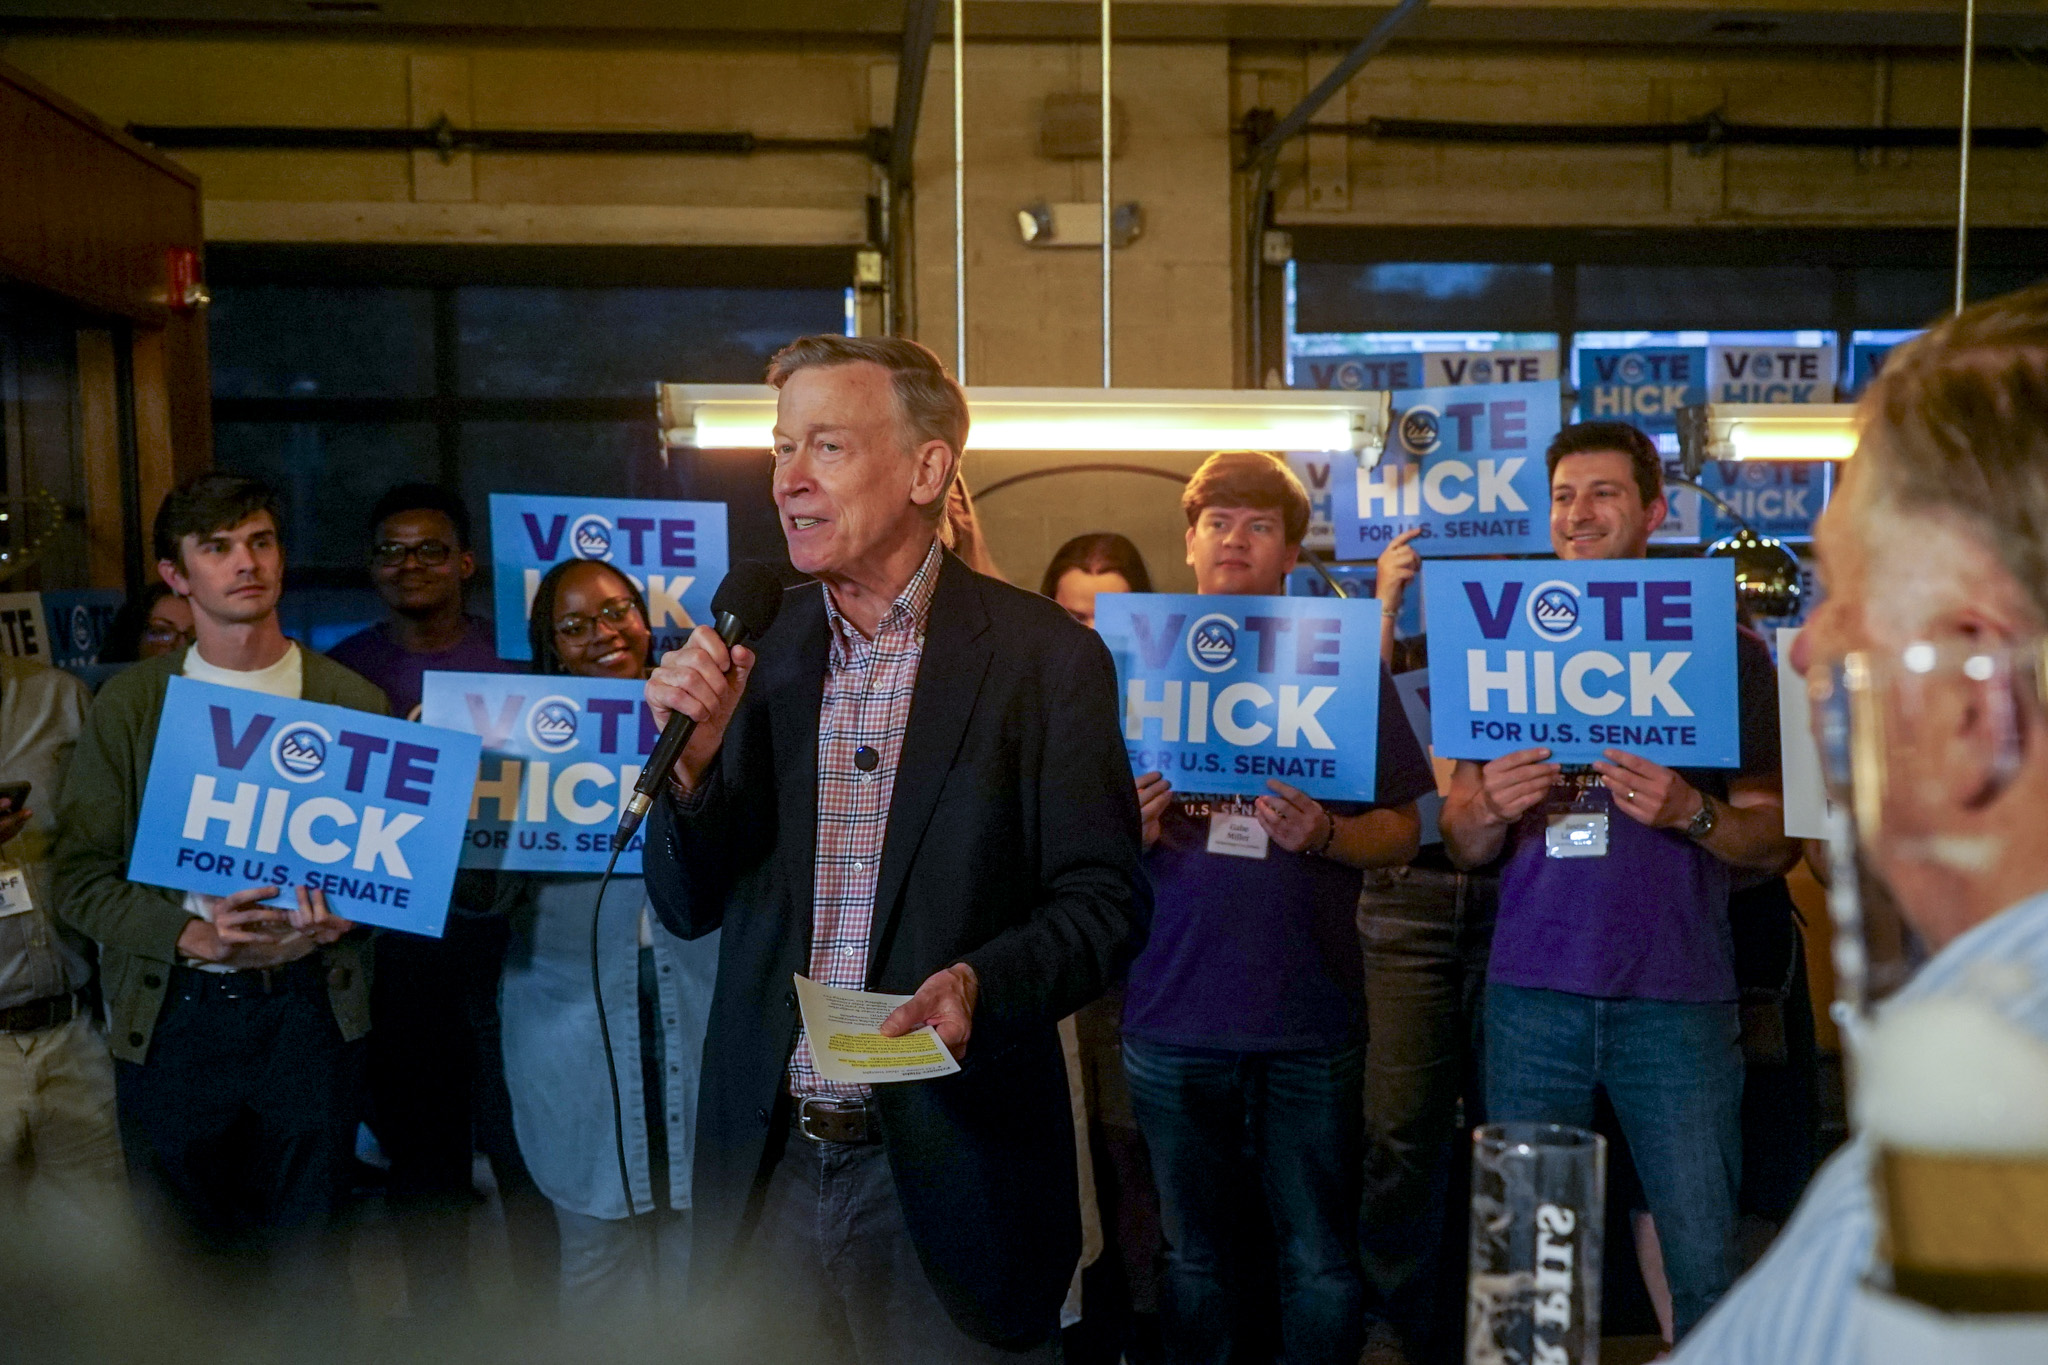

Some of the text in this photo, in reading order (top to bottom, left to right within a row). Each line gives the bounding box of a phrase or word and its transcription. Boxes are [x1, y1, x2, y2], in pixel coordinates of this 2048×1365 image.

[1309, 361, 1409, 389] VOTE
[1441, 357, 1540, 385] VOTE
[1595, 353, 1690, 383] VOTE
[1723, 353, 1820, 381] VOTE
[1593, 384, 1689, 416] HICK
[1391, 401, 1527, 455] OTE
[1356, 457, 1529, 519] HICK
[1716, 488, 1809, 519] HICK
[521, 512, 697, 567] VOTE
[1359, 525, 1393, 542] FOR
[1445, 518, 1531, 538] SENATE
[1462, 579, 1693, 643] VOTE
[1130, 613, 1342, 676] VOTE
[1466, 649, 1696, 717] HICK
[1125, 679, 1339, 750] HICK
[1470, 720, 1697, 746] FOR U.S. SENATE
[208, 704, 441, 806] VOTE
[1179, 751, 1227, 773] U.S.
[1234, 755, 1337, 778] SENATE
[182, 773, 426, 880] HICK
[519, 831, 568, 851] U.S.
[575, 833, 645, 852] SENA
[176, 847, 411, 909] FOR U.S. SENATE
